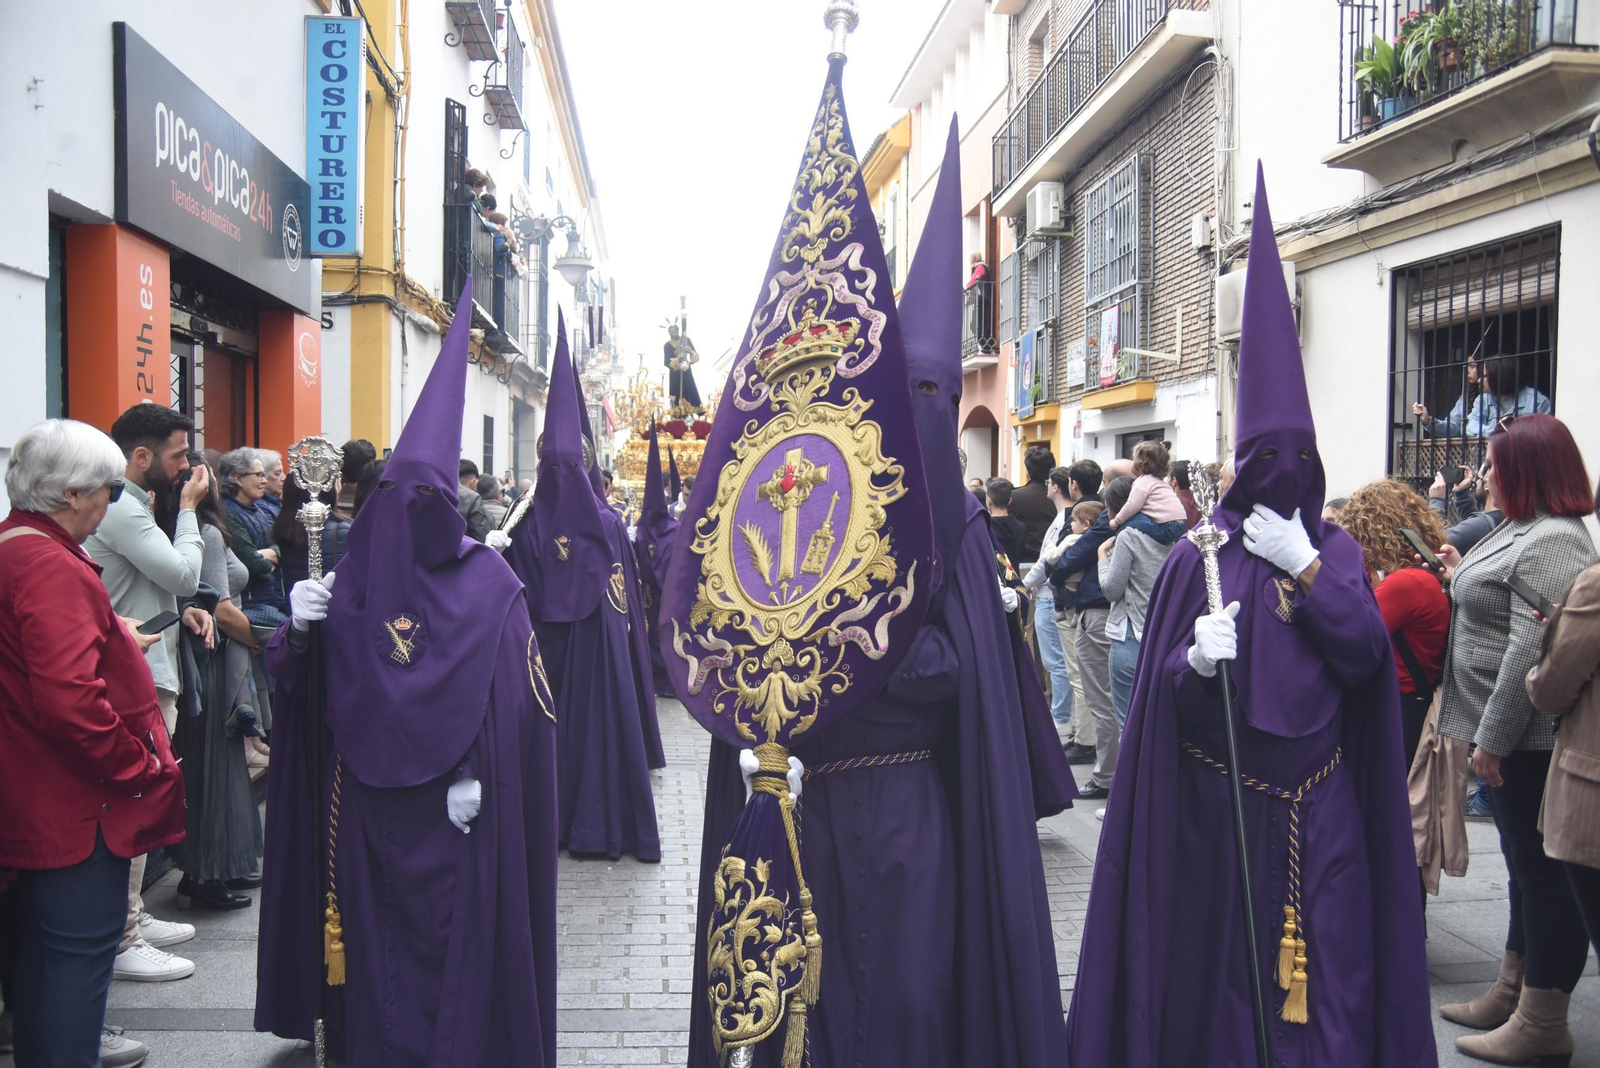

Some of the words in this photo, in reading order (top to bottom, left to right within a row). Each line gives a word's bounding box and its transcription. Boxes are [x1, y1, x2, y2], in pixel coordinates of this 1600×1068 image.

[324, 23, 345, 34] EL
[318, 39, 348, 249] COSTURERO
[171, 179, 200, 217] Tiendas
[201, 204, 242, 242] automáticas
